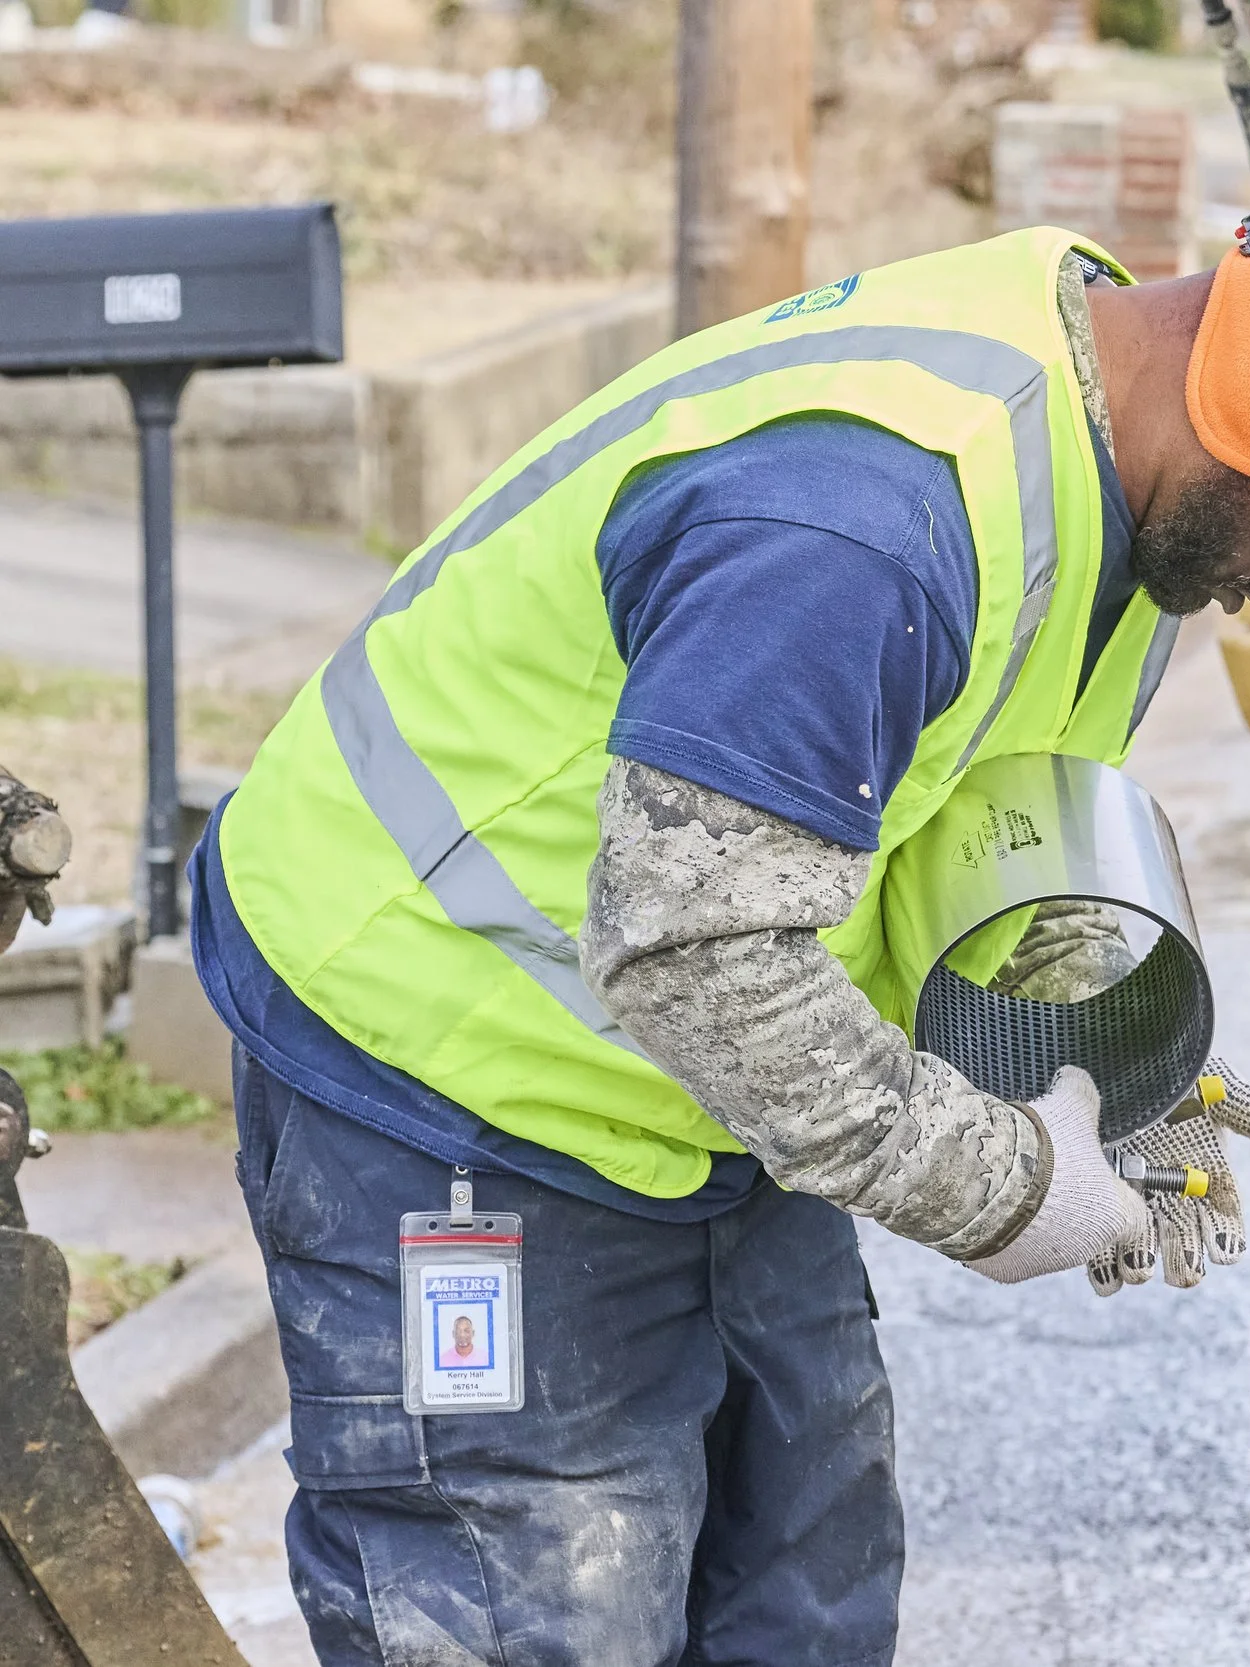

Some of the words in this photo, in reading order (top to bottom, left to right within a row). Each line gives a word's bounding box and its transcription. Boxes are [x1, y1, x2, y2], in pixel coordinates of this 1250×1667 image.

[962, 840, 973, 862] ROTATE
[427, 1277, 499, 1291] METRO
[427, 1392, 450, 1400] System
